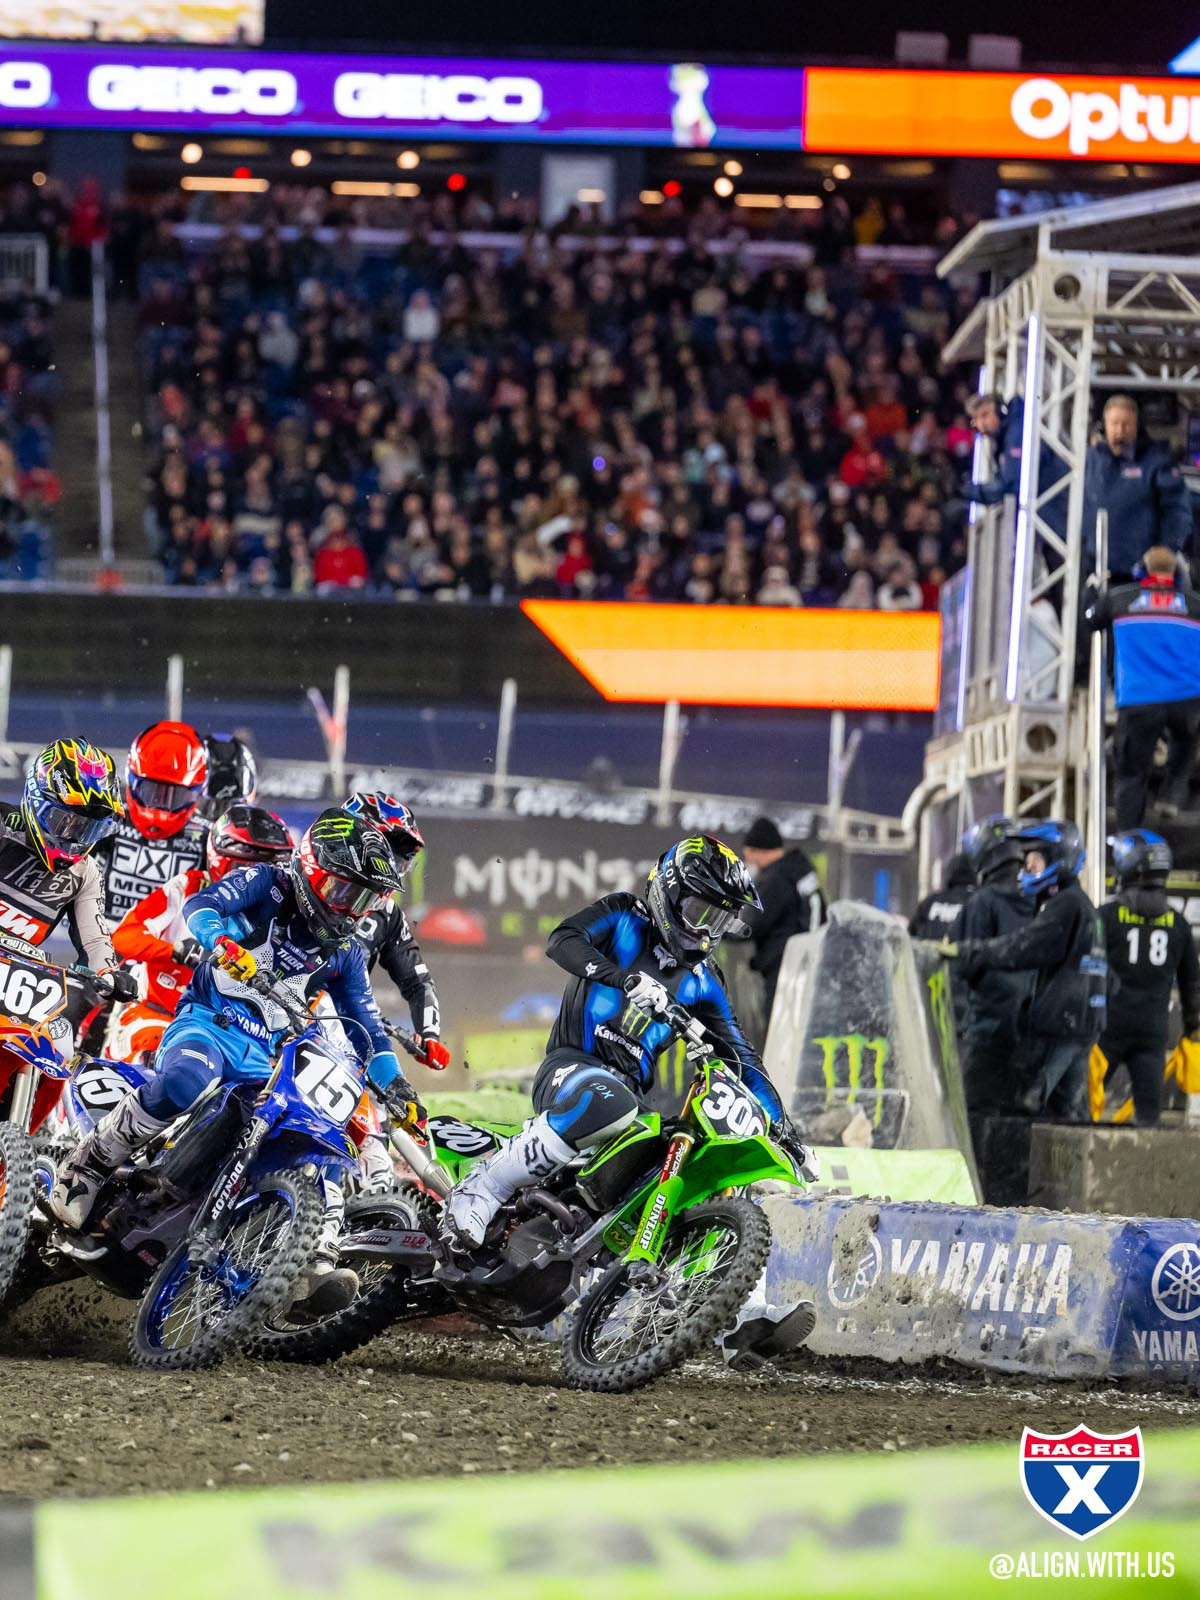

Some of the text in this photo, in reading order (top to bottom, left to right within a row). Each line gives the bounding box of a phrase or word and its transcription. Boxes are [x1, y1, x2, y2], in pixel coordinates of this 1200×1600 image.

[88, 65, 297, 115] GEICO
[334, 73, 542, 122] GEICO
[1010, 78, 1200, 155] Optu
[664, 859, 678, 889] FOX
[1126, 927, 1169, 966] 18
[236, 1014, 273, 1041] YAMAH
[594, 1024, 644, 1060] Kawasaki
[294, 1048, 363, 1124] 15
[590, 1081, 616, 1100] FOX
[702, 1081, 764, 1137] 300
[428, 1119, 492, 1152] 300
[211, 1160, 246, 1221] DUNLOP
[640, 1192, 668, 1251] DUNLOP
[891, 1238, 1072, 1316] YAMAHA
